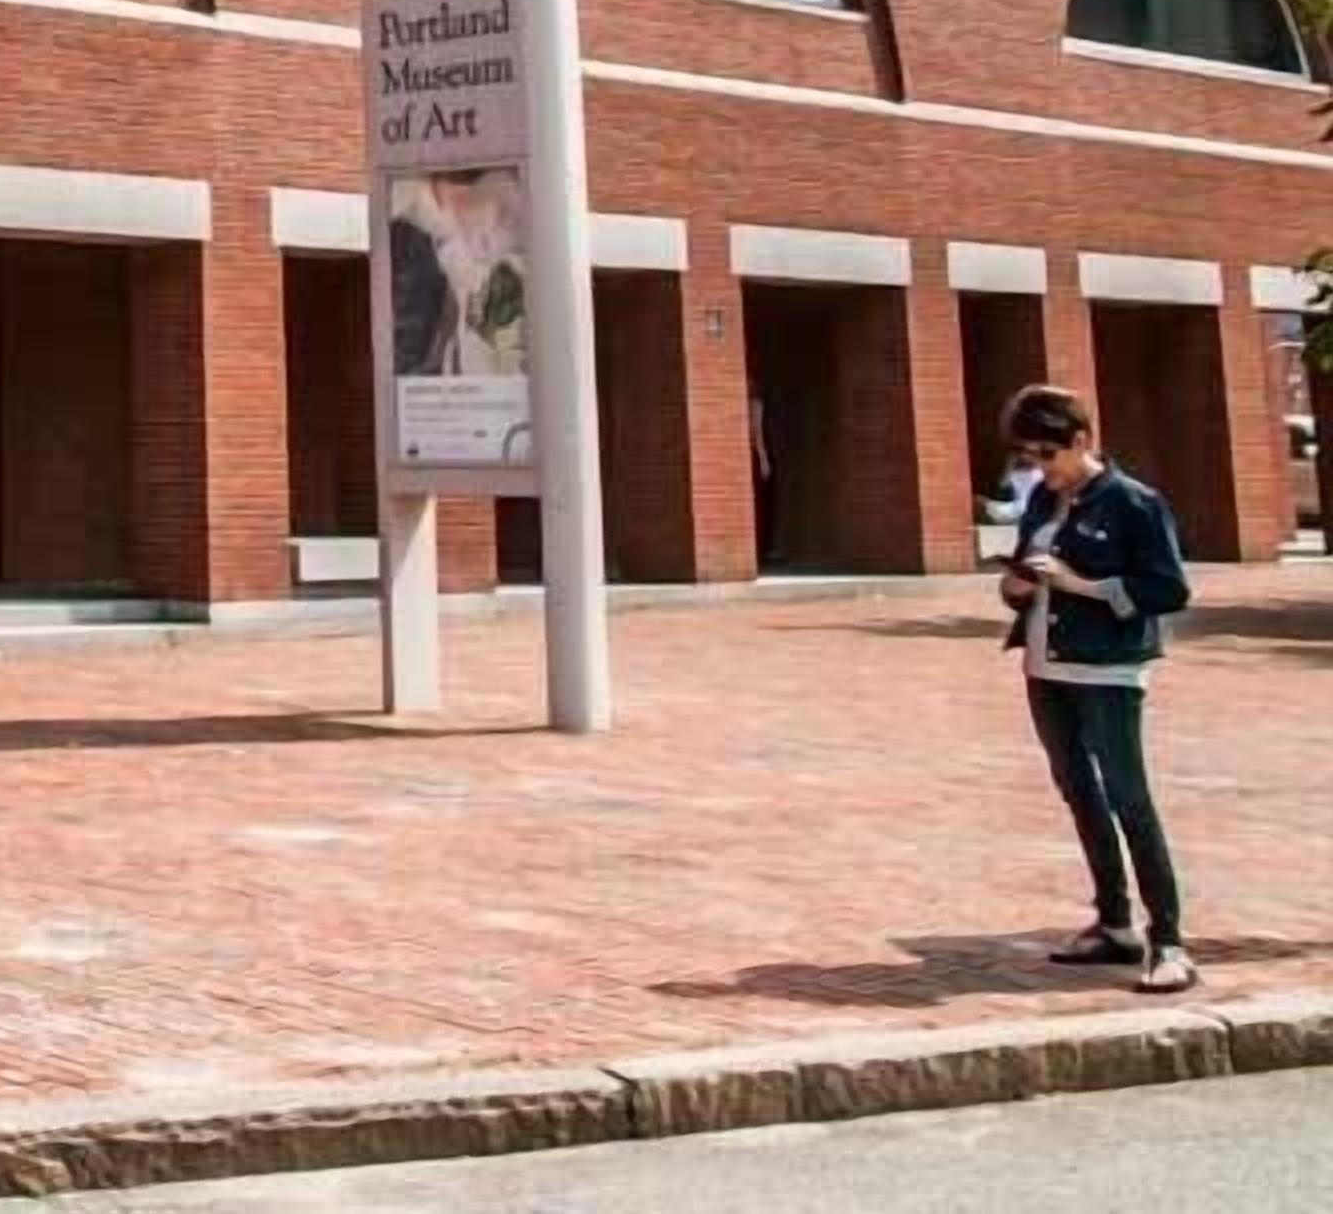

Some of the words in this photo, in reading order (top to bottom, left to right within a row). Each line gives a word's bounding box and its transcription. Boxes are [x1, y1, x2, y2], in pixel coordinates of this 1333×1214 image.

[381, 56, 514, 95] Museum
[382, 101, 416, 144] of
[422, 99, 479, 140] Art
